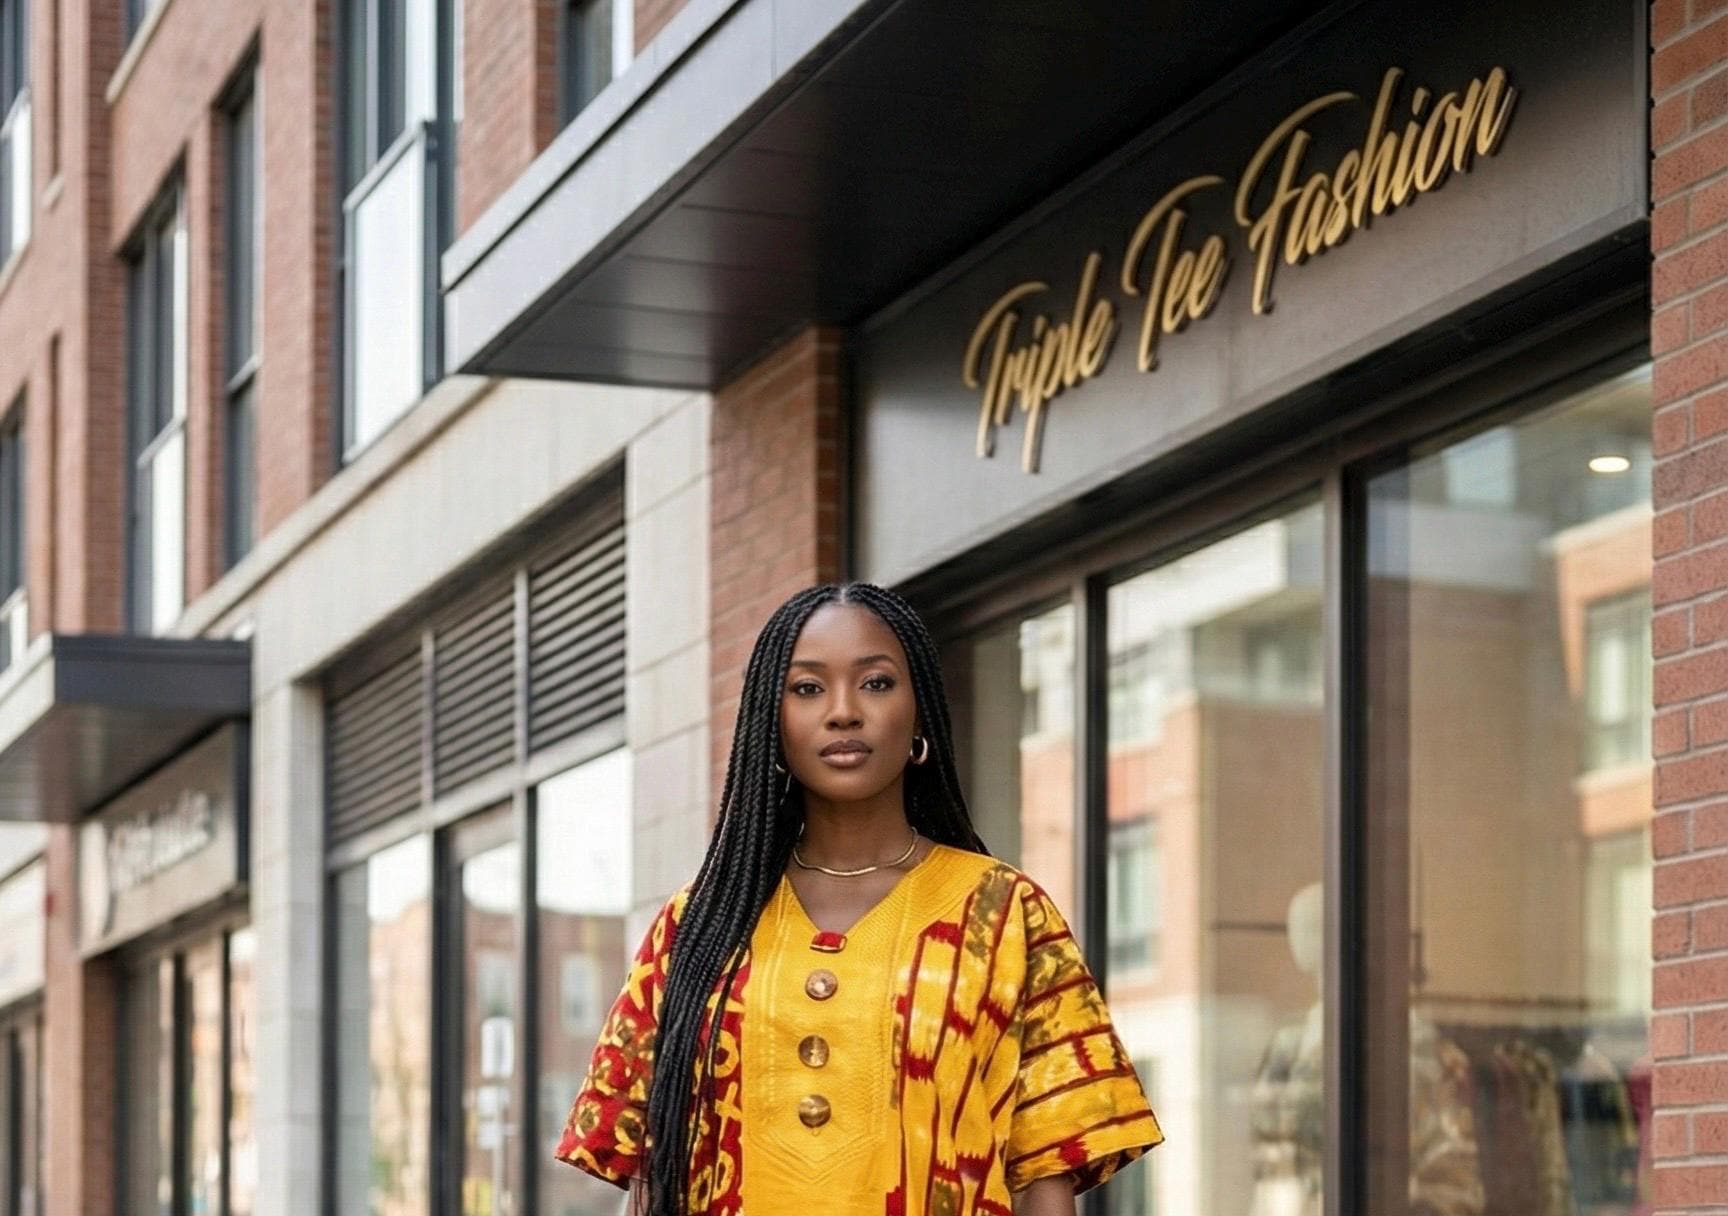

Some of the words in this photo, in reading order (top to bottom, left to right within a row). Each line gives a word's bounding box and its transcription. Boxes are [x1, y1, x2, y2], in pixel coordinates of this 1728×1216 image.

[963, 252, 1117, 473] Triple
[1121, 175, 1230, 372] Tee
[1234, 66, 1517, 314] Fashion
